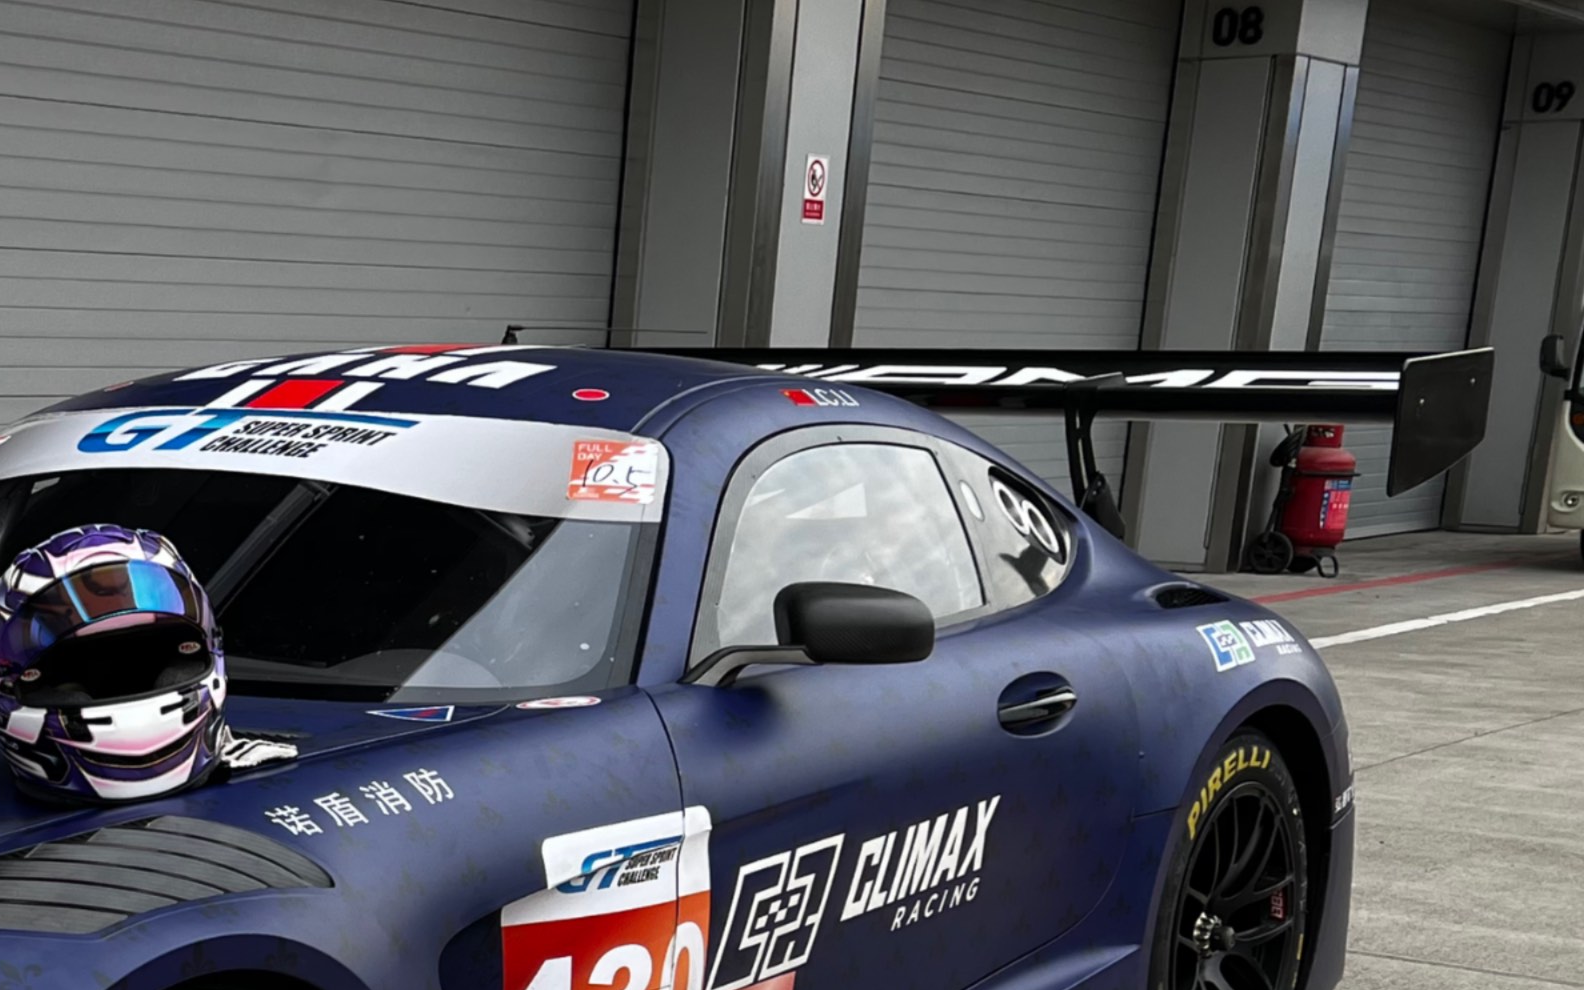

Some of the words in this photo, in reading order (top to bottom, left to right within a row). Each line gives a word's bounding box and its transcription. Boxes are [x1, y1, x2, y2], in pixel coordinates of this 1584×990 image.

[1212, 6, 1264, 47] 08
[1531, 80, 1576, 114] 09
[200, 436, 325, 458] CHALLENGE
[233, 420, 310, 440] SUPER
[315, 424, 396, 448] SPRINT
[578, 443, 613, 454] FULL
[577, 452, 603, 461] DAY
[264, 768, 454, 836] 诺盾消防
[1187, 745, 1272, 840] PIRELLI
[840, 795, 1001, 922] CLIMAX
[618, 866, 661, 887] CHALLENGE
[890, 877, 981, 931] RACING
